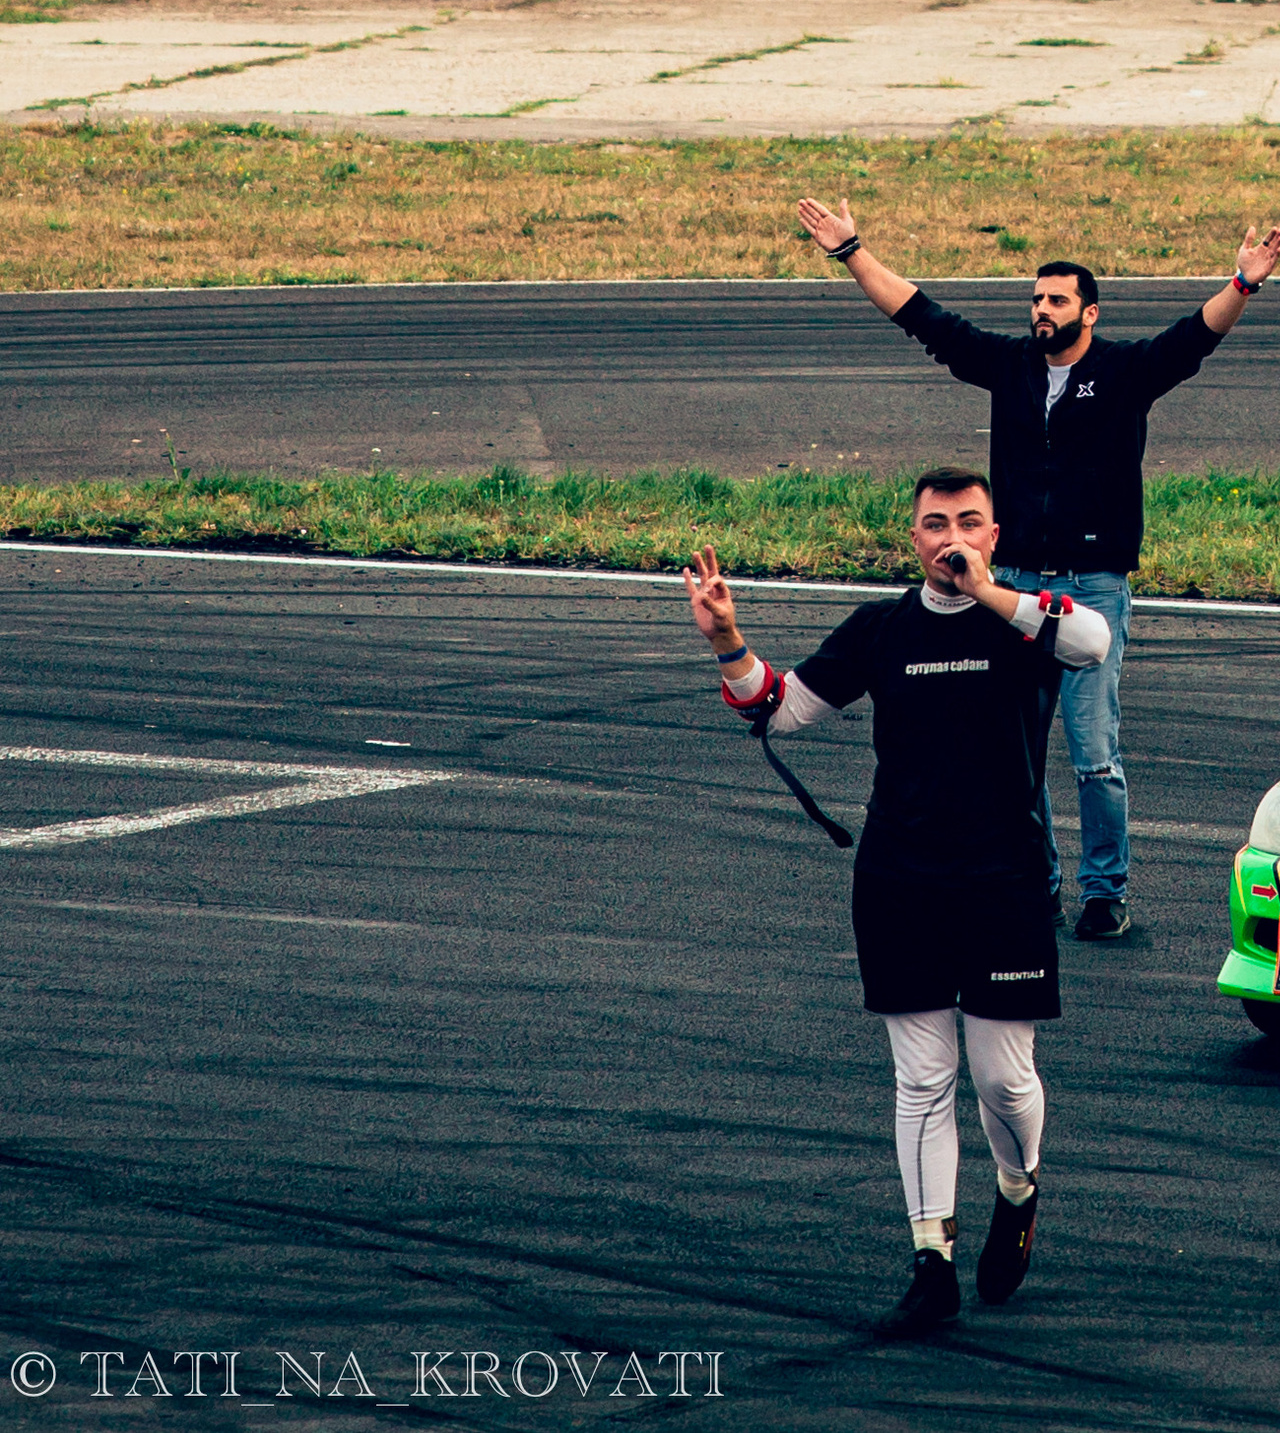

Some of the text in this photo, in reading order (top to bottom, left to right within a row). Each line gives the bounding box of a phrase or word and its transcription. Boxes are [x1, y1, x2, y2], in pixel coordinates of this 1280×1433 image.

[905, 659, 989, 676] сутулая собака
[991, 968, 1045, 981] ESSENTIALS
